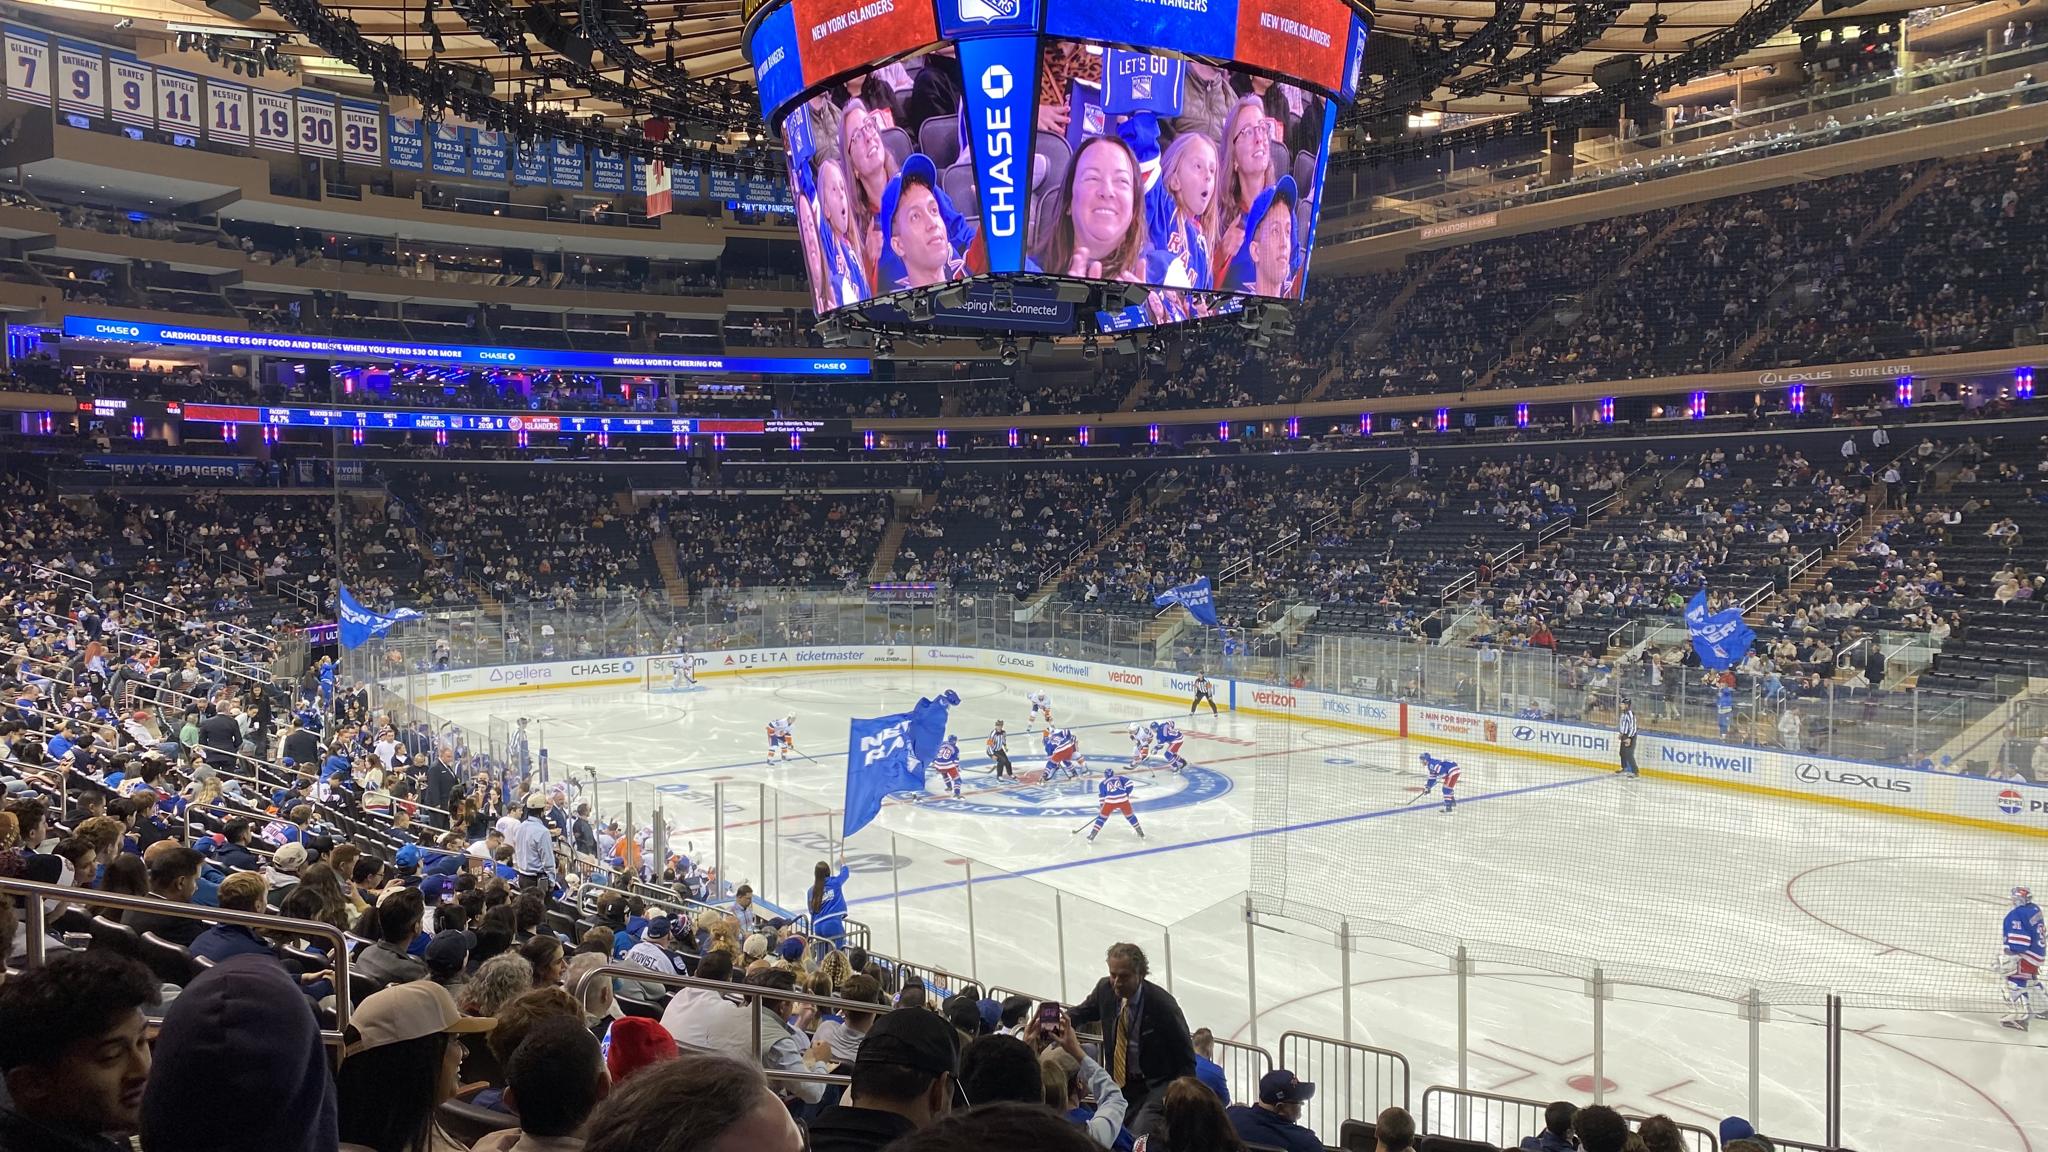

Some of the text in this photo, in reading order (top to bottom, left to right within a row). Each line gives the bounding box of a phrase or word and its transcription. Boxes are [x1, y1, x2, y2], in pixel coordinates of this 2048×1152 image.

[812, 0, 895, 41] NEW YORK ISLANDERS
[1260, 12, 1332, 49] NEW YORK ISLANDERS
[1120, 55, 1168, 76] LET'S GO
[18, 56, 36, 88] 7
[118, 68, 144, 82] GRAVES
[72, 70, 90, 100] 9
[123, 81, 141, 110] 9
[213, 90, 242, 102] MESSIER
[166, 91, 192, 121] 11
[216, 102, 241, 131] 11
[260, 109, 288, 138] 19
[302, 116, 333, 145] 30
[346, 124, 377, 152] 35
[391, 137, 422, 148] 1927-28
[394, 146, 418, 155] STANLEY
[434, 142, 463, 153] 1932-33
[473, 148, 504, 158] 1939-40
[437, 152, 460, 160] STANLEY
[476, 157, 500, 165] STANLEY
[390, 159, 423, 169] CHAMPIONS
[553, 157, 582, 168] 1926-27
[595, 161, 624, 171] 1931-32
[433, 165, 465, 174] CHAMPIONS
[472, 169, 504, 179] CHAMPIONS
[596, 170, 622, 178] AMERICAN
[986, 105, 1015, 237] CHASE
[516, 174, 547, 183] CHAMPIONS
[552, 180, 583, 188] CHAMPIONS
[598, 177, 620, 185] DIVISION
[594, 183, 624, 191] CHAMPIONS
[1010, 303, 1058, 317] Connected
[97, 325, 129, 336] CHASE
[160, 331, 222, 343] CARDHOLDERS
[223, 336, 239, 345] GET
[240, 337, 250, 346] $5
[251, 338, 267, 346] OFF
[269, 339, 290, 348] FOOD
[291, 341, 310, 350] AND
[342, 344, 367, 352] WHEN
[368, 345, 385, 353] YOU
[386, 346, 411, 355] SPEND
[413, 348, 427, 356] $30
[440, 350, 462, 358] MORE
[480, 352, 507, 360] CHASE
[613, 357, 644, 366] SAVINGS
[645, 359, 671, 367] WORTH
[814, 362, 839, 370] CHASE
[1779, 364, 1912, 382] LEXUS SUITE LEVEL
[324, 417, 329, 425] 3
[358, 418, 366, 427] 11
[388, 419, 393, 428] 5
[416, 419, 445, 428] RANGERS
[469, 417, 474, 428] 1
[478, 422, 494, 430] 20:00
[496, 418, 503, 428] 0
[525, 422, 558, 431] ISLANDERS
[174, 464, 234, 477] RANGERS
[905, 591, 934, 599] ULTRA
[739, 652, 788, 664] DELTA
[796, 651, 865, 662] ticketmaster
[1008, 658, 1035, 668] LEXUS
[505, 666, 553, 684] pellera
[571, 663, 620, 676] CHASE
[1052, 662, 1089, 677] Northwell
[1108, 671, 1143, 685] verizon
[1252, 691, 1297, 709] verizon
[1323, 698, 1350, 714] Infosys
[1358, 703, 1386, 720] Infosys
[1441, 714, 1454, 723] FOR
[1539, 730, 1609, 751] HYUNDAI
[1662, 746, 1752, 773] Northwell
[1825, 770, 1911, 792] LEXUS
